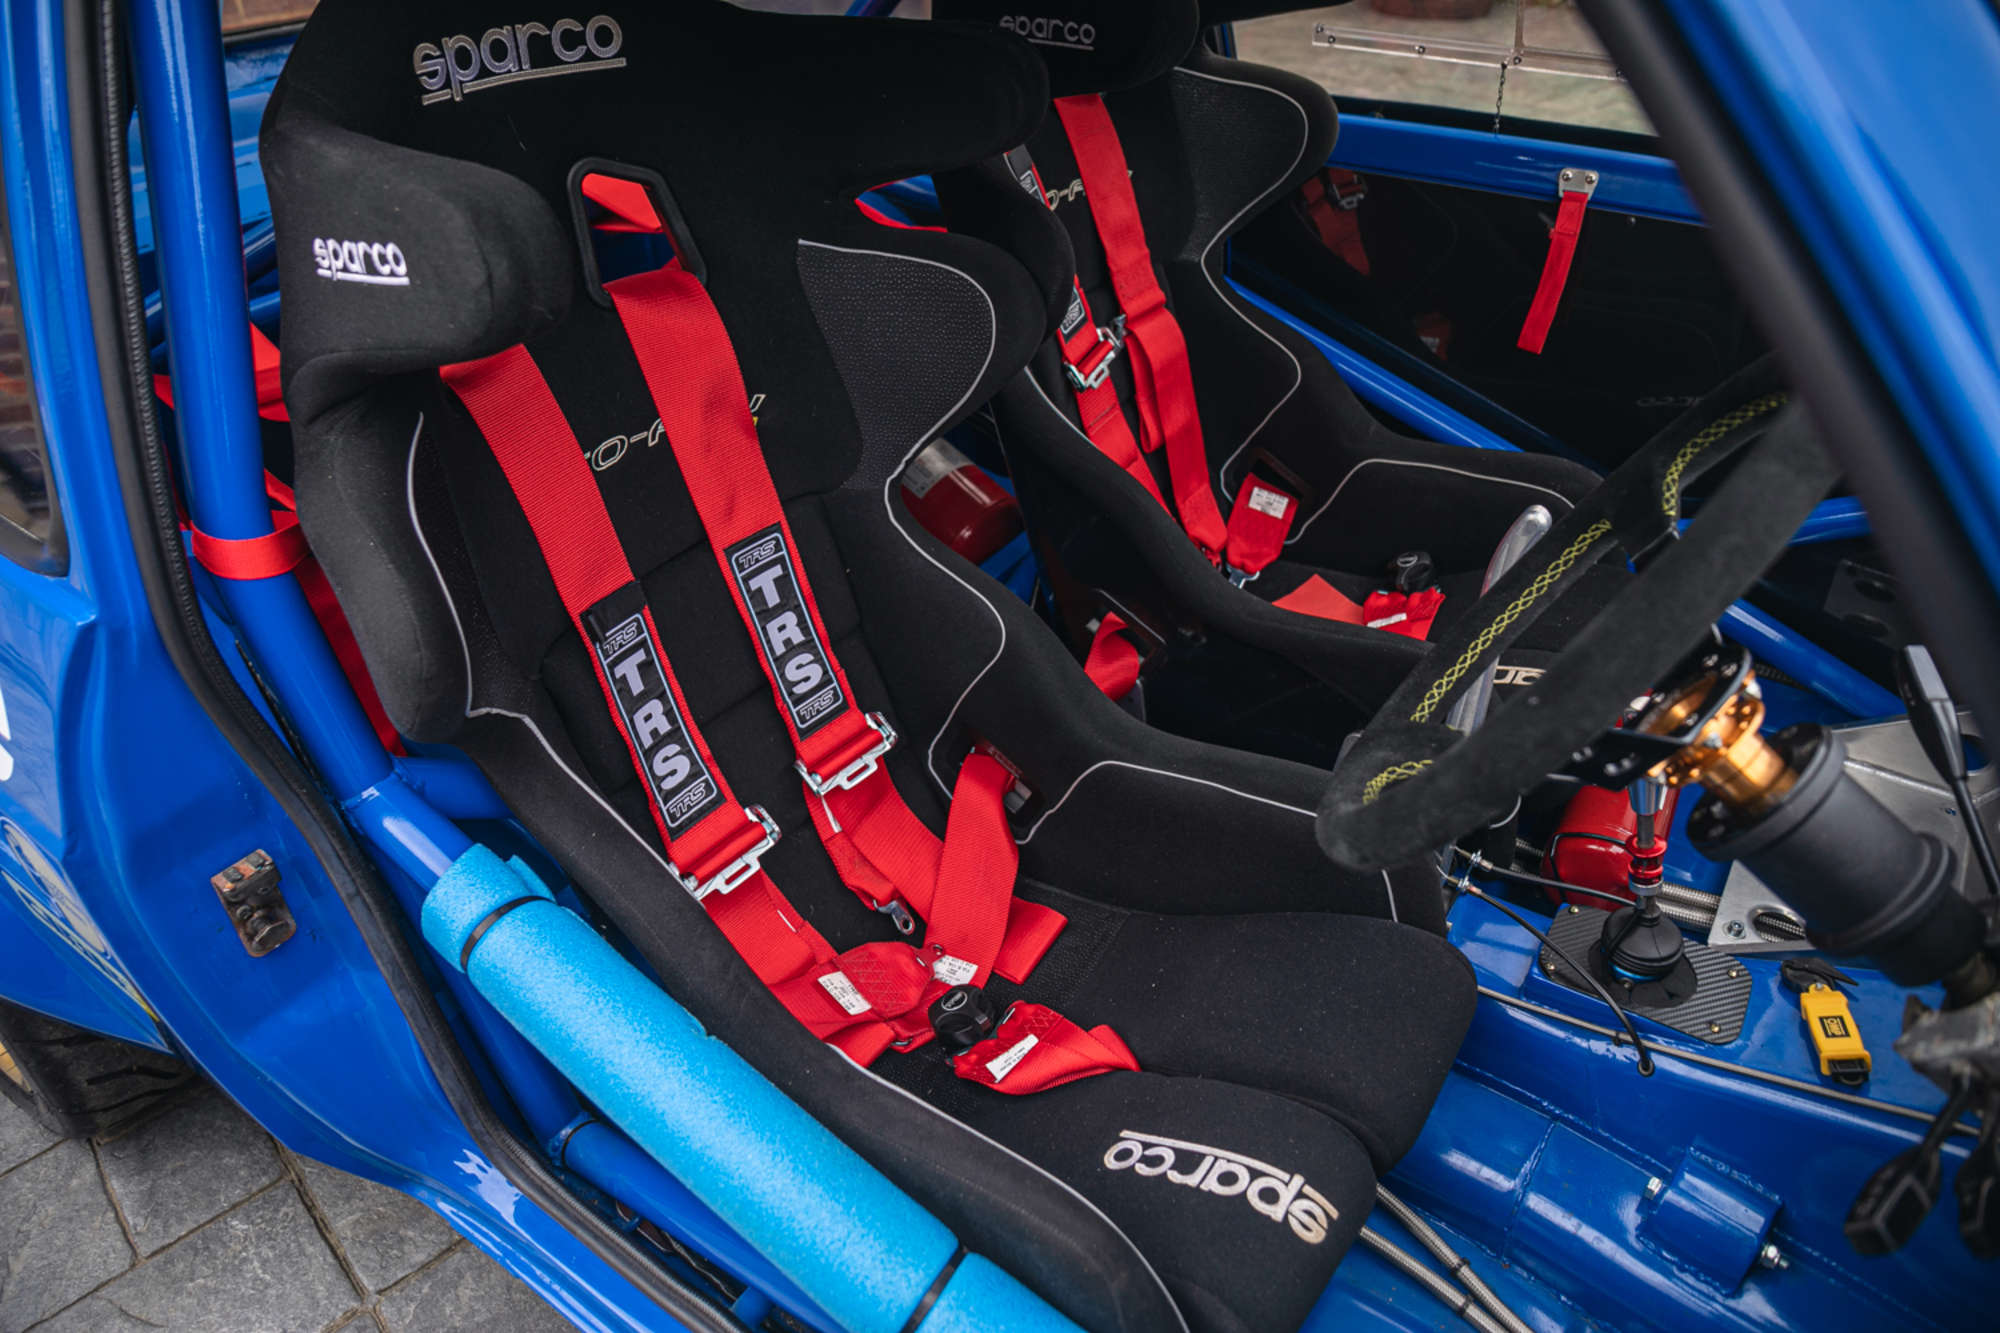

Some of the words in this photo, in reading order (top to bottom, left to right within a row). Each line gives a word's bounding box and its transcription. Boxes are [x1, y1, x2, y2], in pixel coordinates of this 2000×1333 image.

[413, 14, 626, 104] sparco
[313, 237, 410, 285] sparco
[738, 540, 777, 569] TRS
[603, 622, 637, 655] TRS
[748, 564, 823, 694] TRS
[614, 648, 691, 790] TRS
[799, 689, 834, 720] TRS
[669, 782, 706, 818] TRS
[1104, 1130, 1339, 1245] sparco
